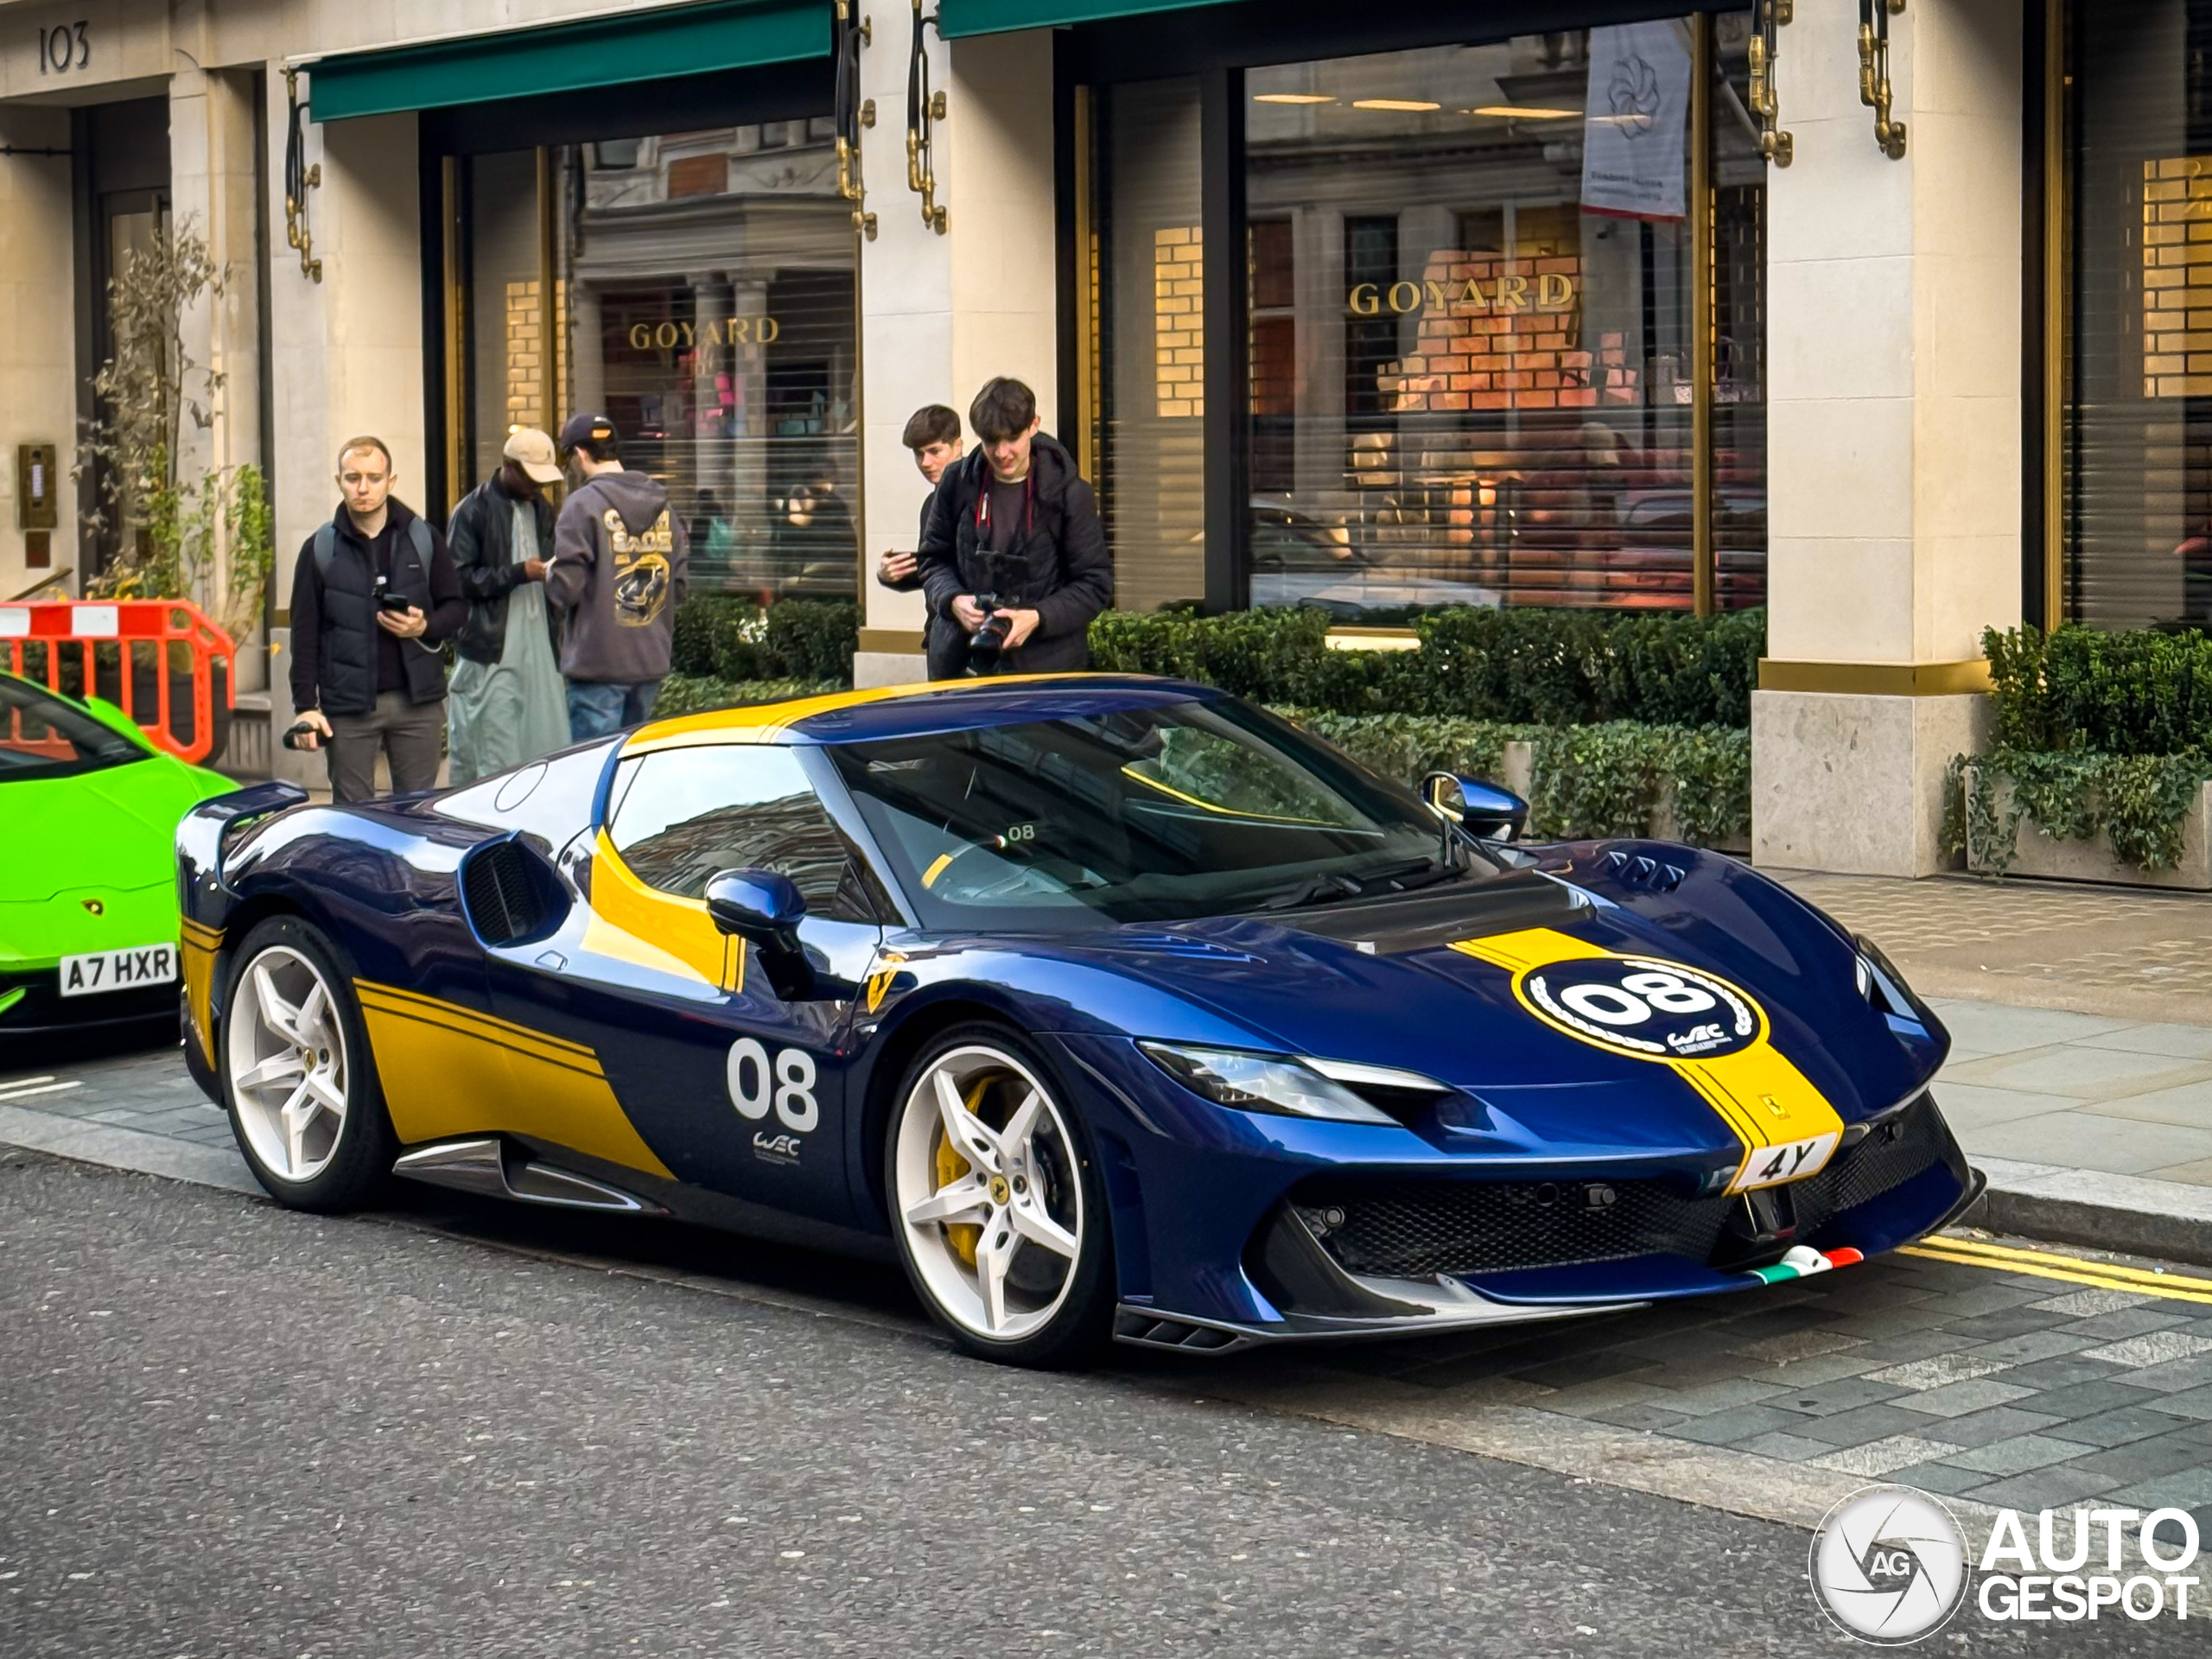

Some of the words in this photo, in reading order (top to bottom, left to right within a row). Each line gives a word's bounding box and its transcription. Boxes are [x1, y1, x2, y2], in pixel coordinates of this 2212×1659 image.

[40, 19, 90, 75] 103
[1350, 273, 1573, 315] GOYARD
[629, 317, 779, 350] GOYARD
[1007, 824, 1035, 842] 08
[67, 957, 105, 990] A7
[114, 948, 170, 983] HXR
[1560, 972, 1716, 1026] 08
[727, 1037, 819, 1133] 08
[753, 1131, 801, 1157] WEC
